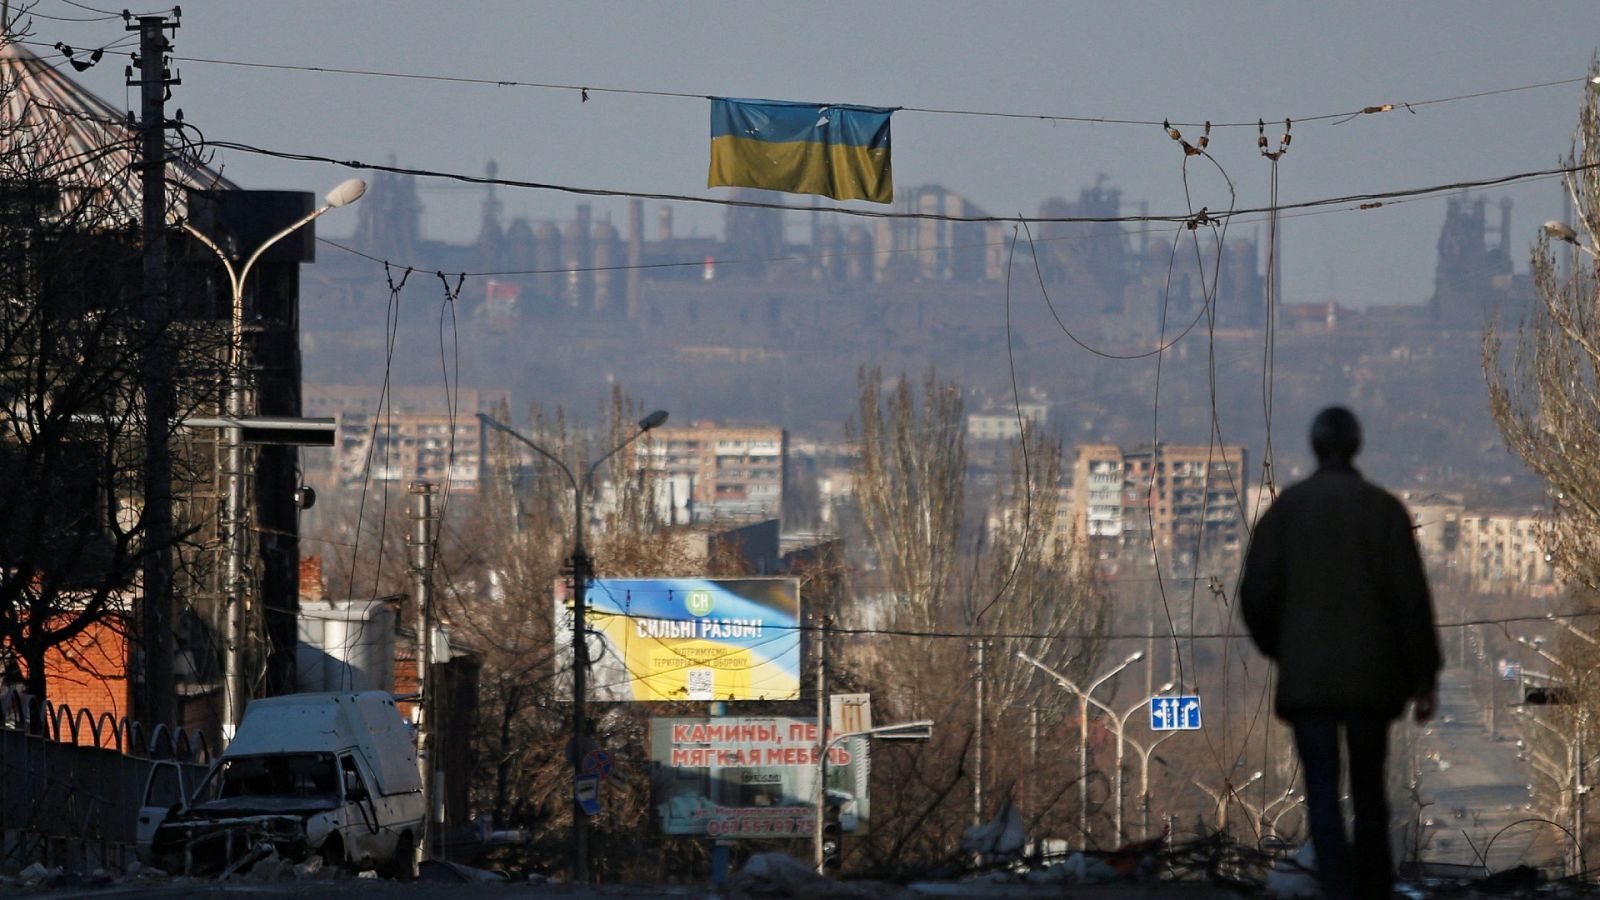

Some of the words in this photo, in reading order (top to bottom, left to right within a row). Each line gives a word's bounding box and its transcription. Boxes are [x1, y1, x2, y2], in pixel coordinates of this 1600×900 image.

[692, 593, 709, 609] СН
[637, 619, 697, 638] СИЛЬНІ
[702, 619, 763, 638] РАЗОМ!
[673, 723, 783, 745] КАМИНЫ,
[789, 723, 849, 742] ПЕ
[672, 748, 761, 767] МЯГКАЯ
[767, 747, 851, 766] МЕБЕЛЬ
